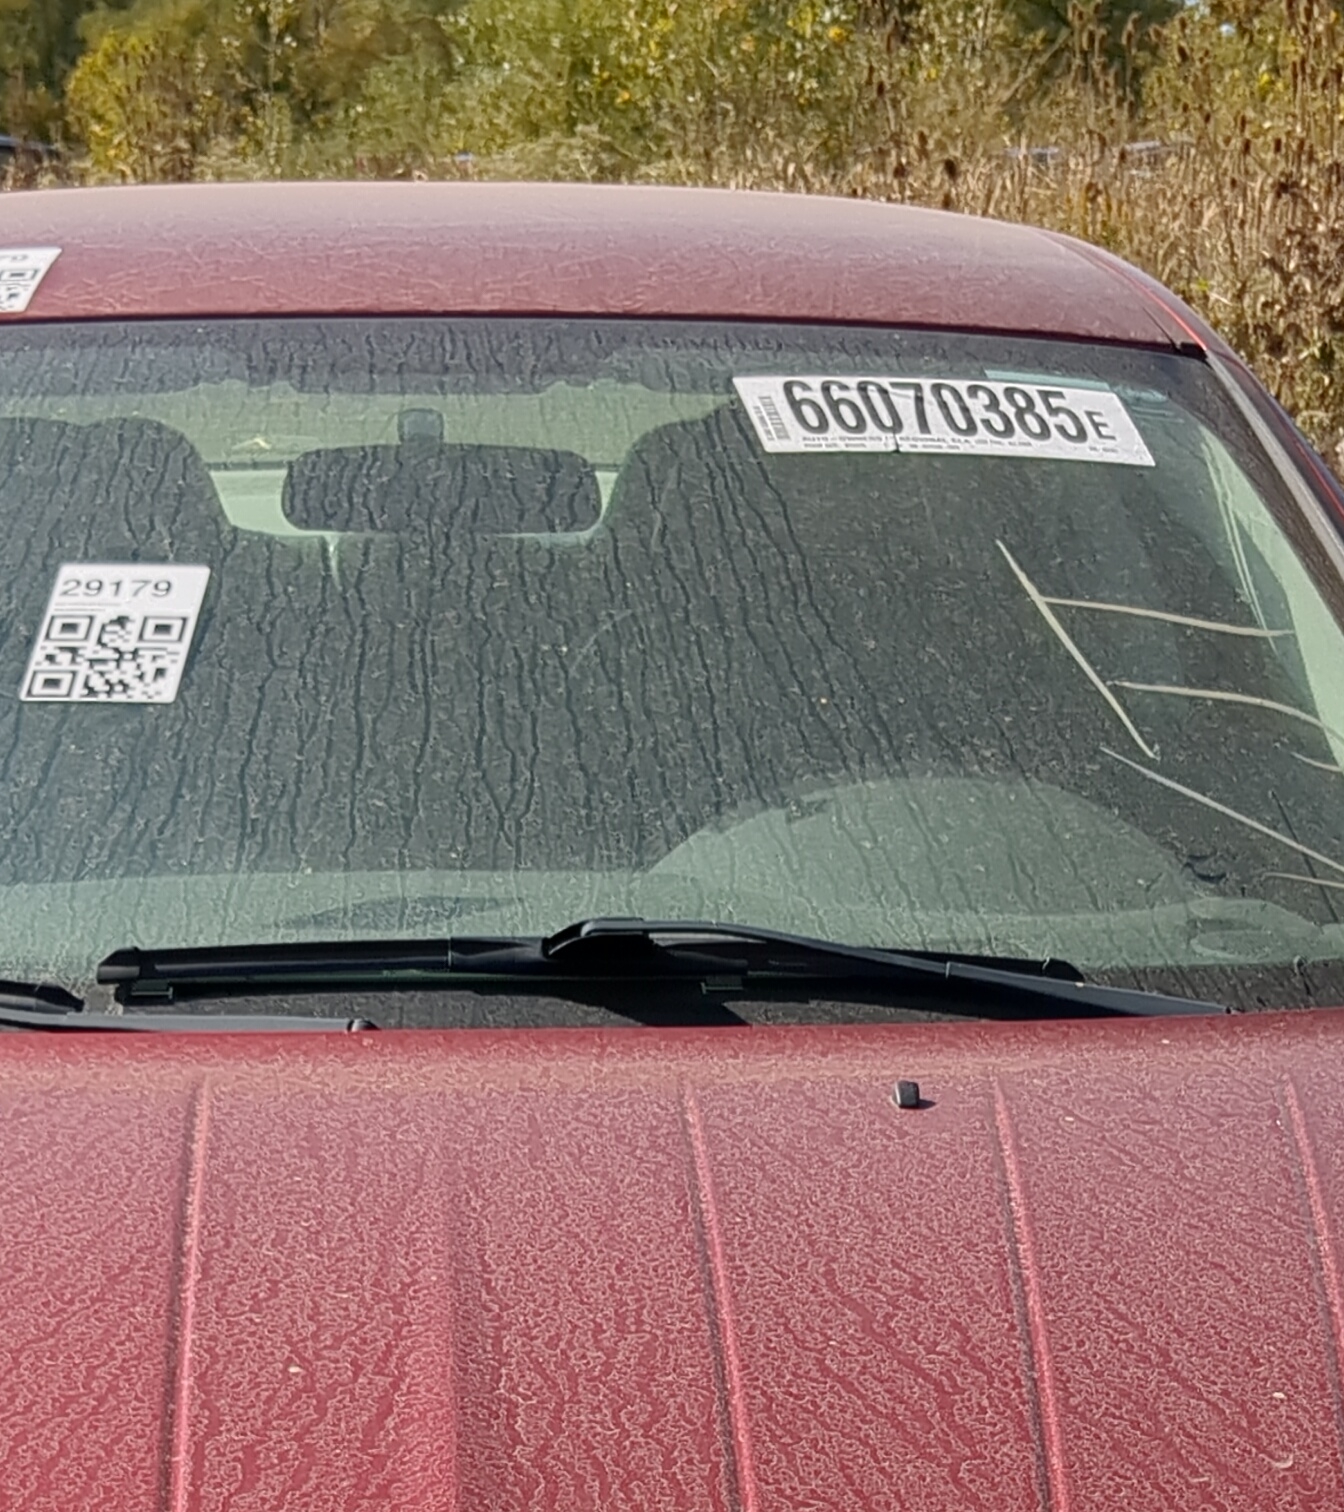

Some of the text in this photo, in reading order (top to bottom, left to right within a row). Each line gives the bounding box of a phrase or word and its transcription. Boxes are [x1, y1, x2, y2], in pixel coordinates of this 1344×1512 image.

[783, 380, 1088, 444] 66070385
[1084, 410, 1116, 441] E
[59, 579, 173, 597] 29179
